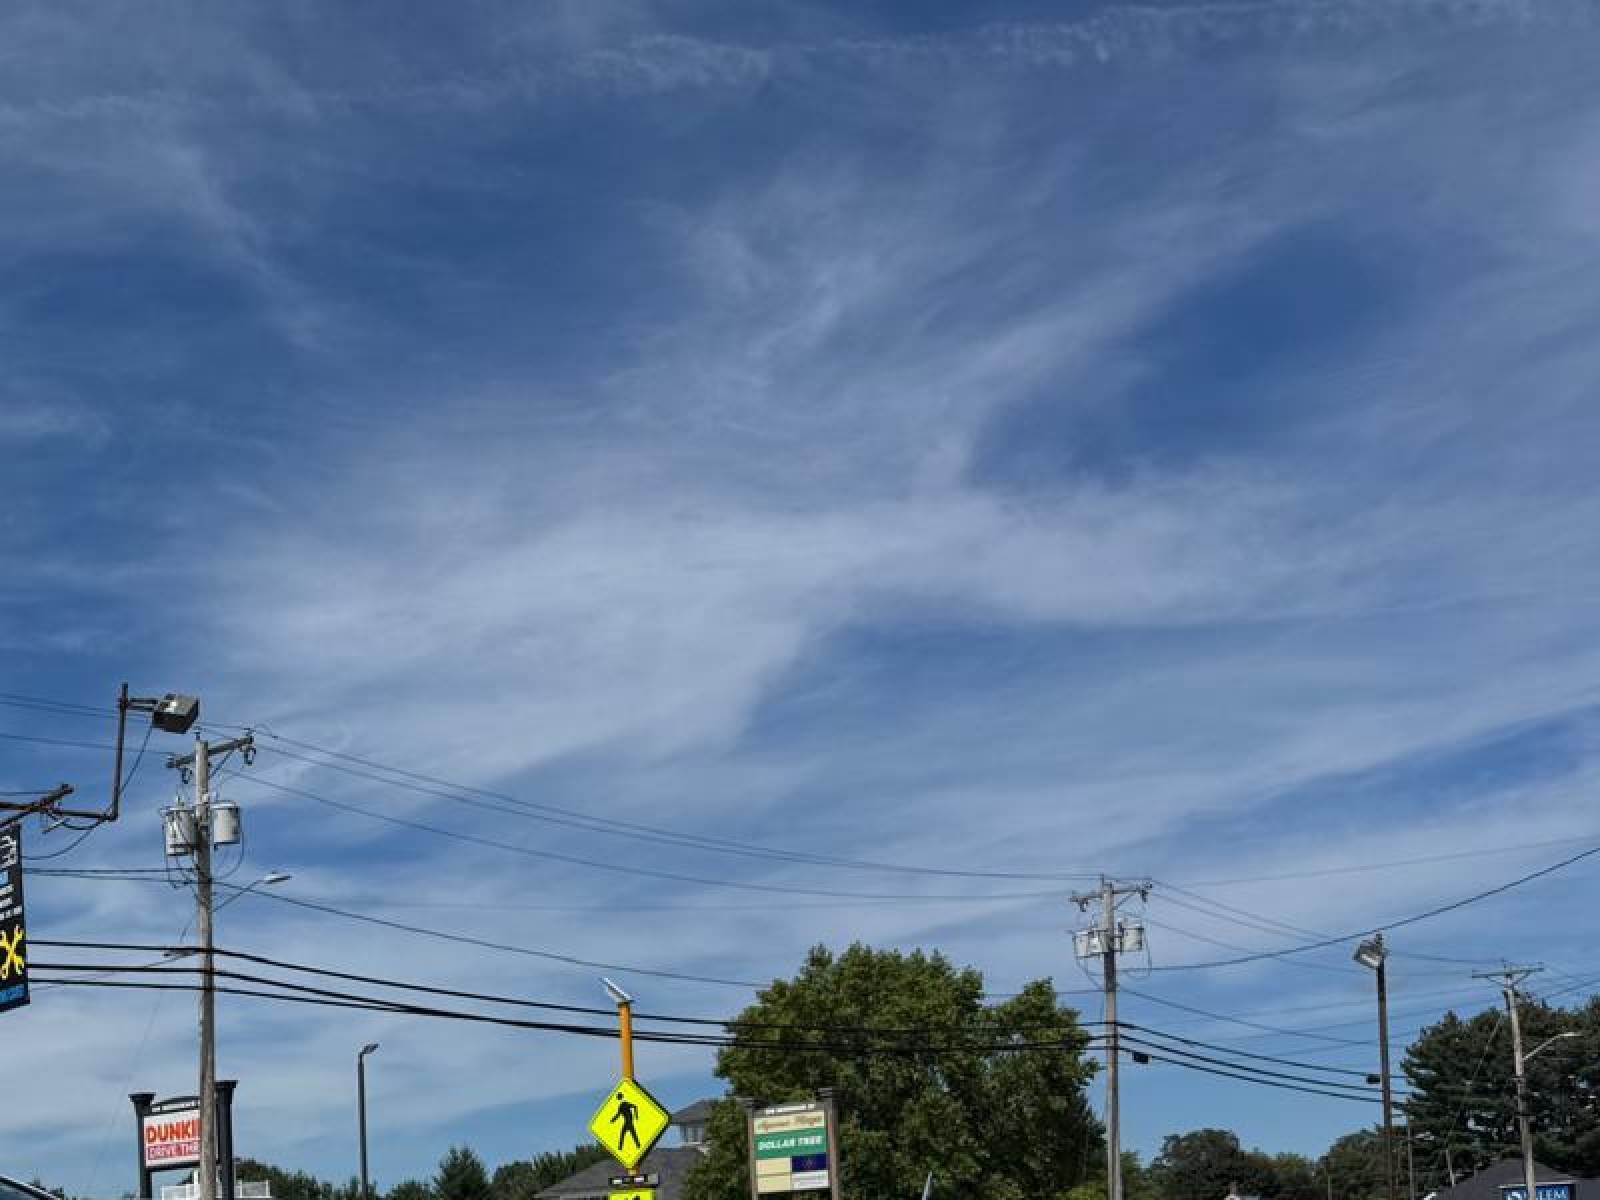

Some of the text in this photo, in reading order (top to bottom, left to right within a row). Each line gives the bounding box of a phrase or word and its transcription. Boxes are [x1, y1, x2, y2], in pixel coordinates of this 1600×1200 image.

[146, 1119, 201, 1143] DUNKI
[758, 1136, 822, 1151] DOLLAR TREE
